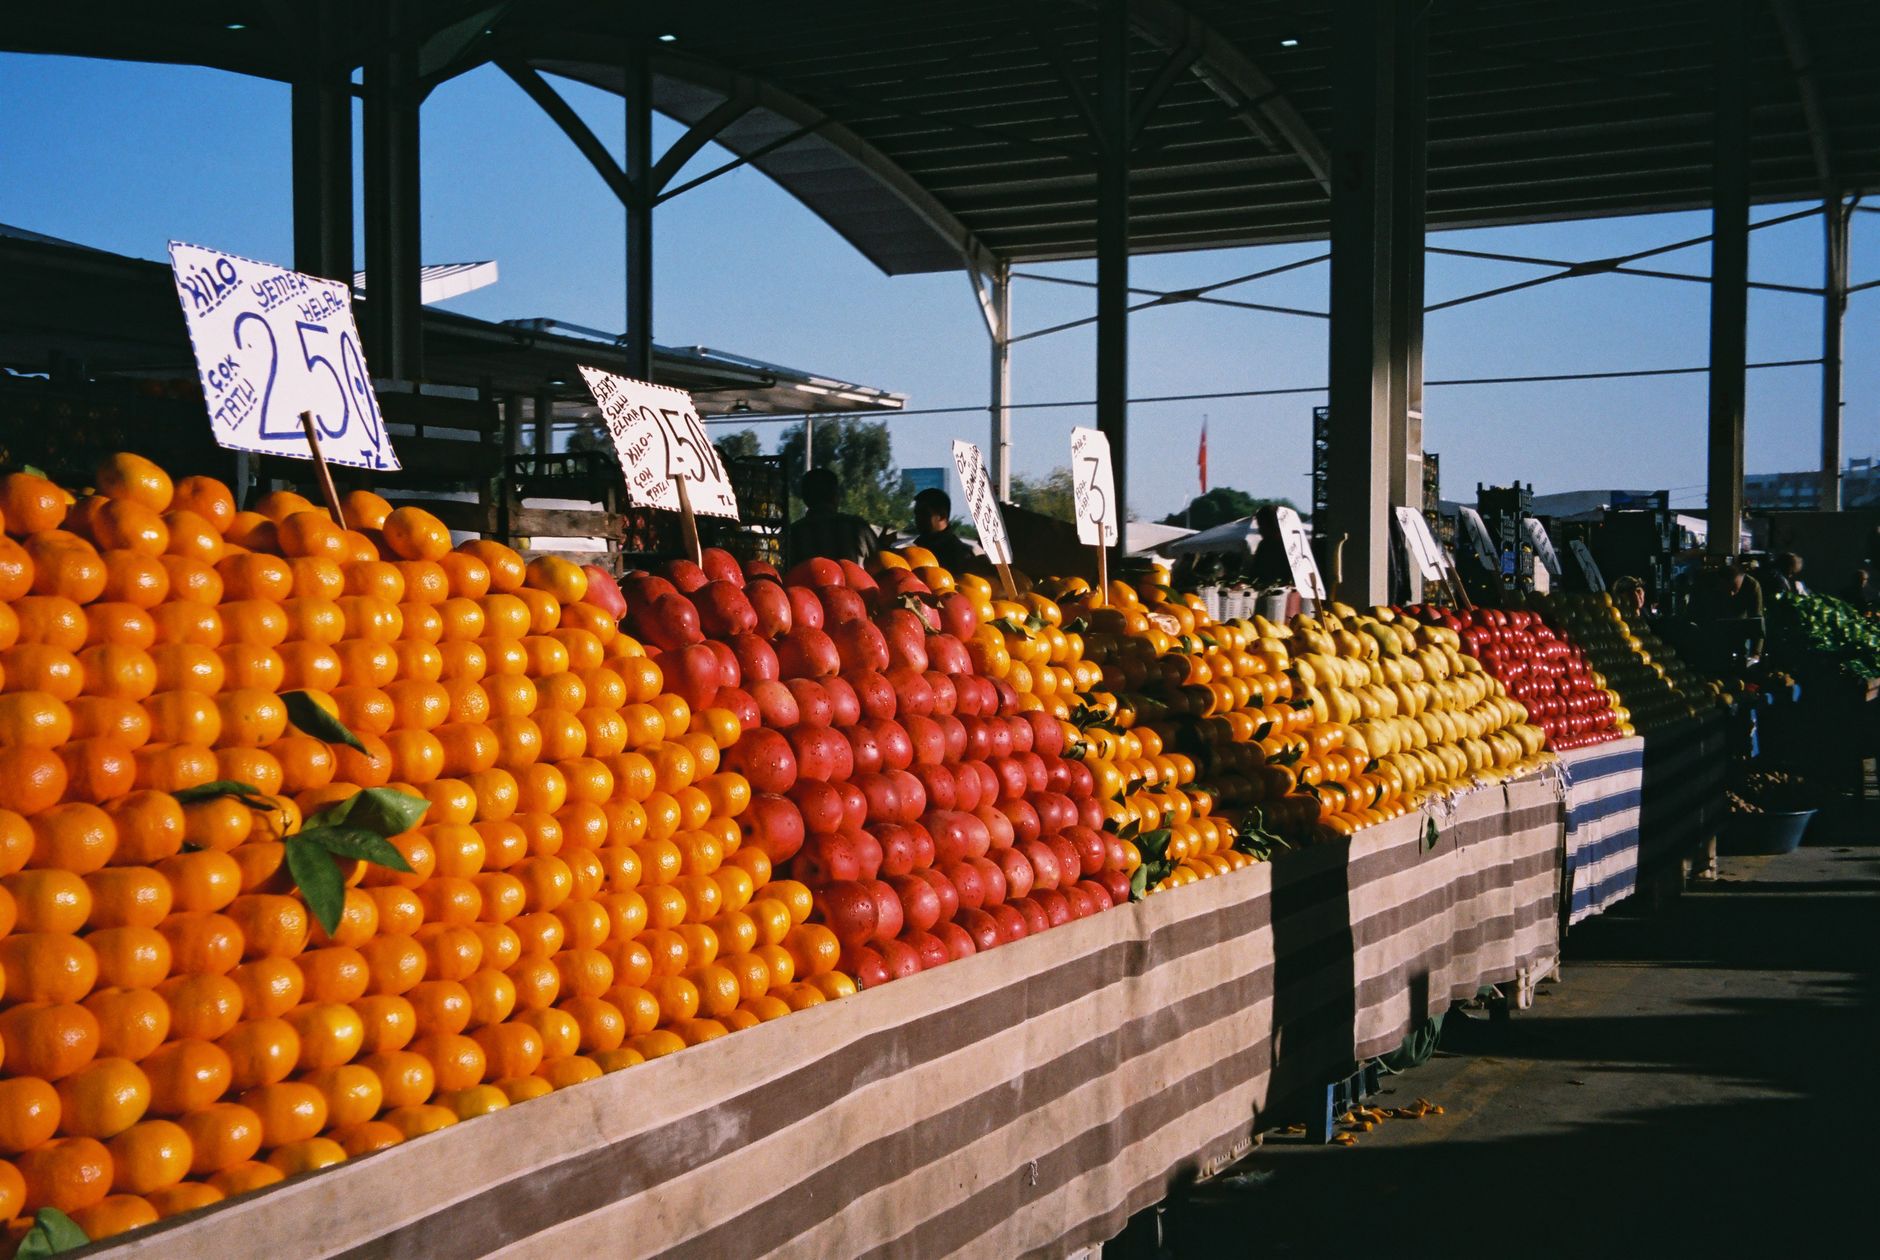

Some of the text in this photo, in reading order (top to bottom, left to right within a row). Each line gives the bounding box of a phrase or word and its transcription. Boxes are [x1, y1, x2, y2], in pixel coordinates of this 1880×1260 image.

[251, 273, 309, 308] YEMEK
[297, 290, 343, 322] HELAL
[208, 354, 241, 393] ÇOK
[214, 377, 256, 427] TATLI
[606, 394, 629, 420] SULU
[360, 449, 389, 469] TL
[717, 494, 734, 506] TL
[1083, 457, 1106, 525] 3
[1105, 525, 1119, 538] TL
